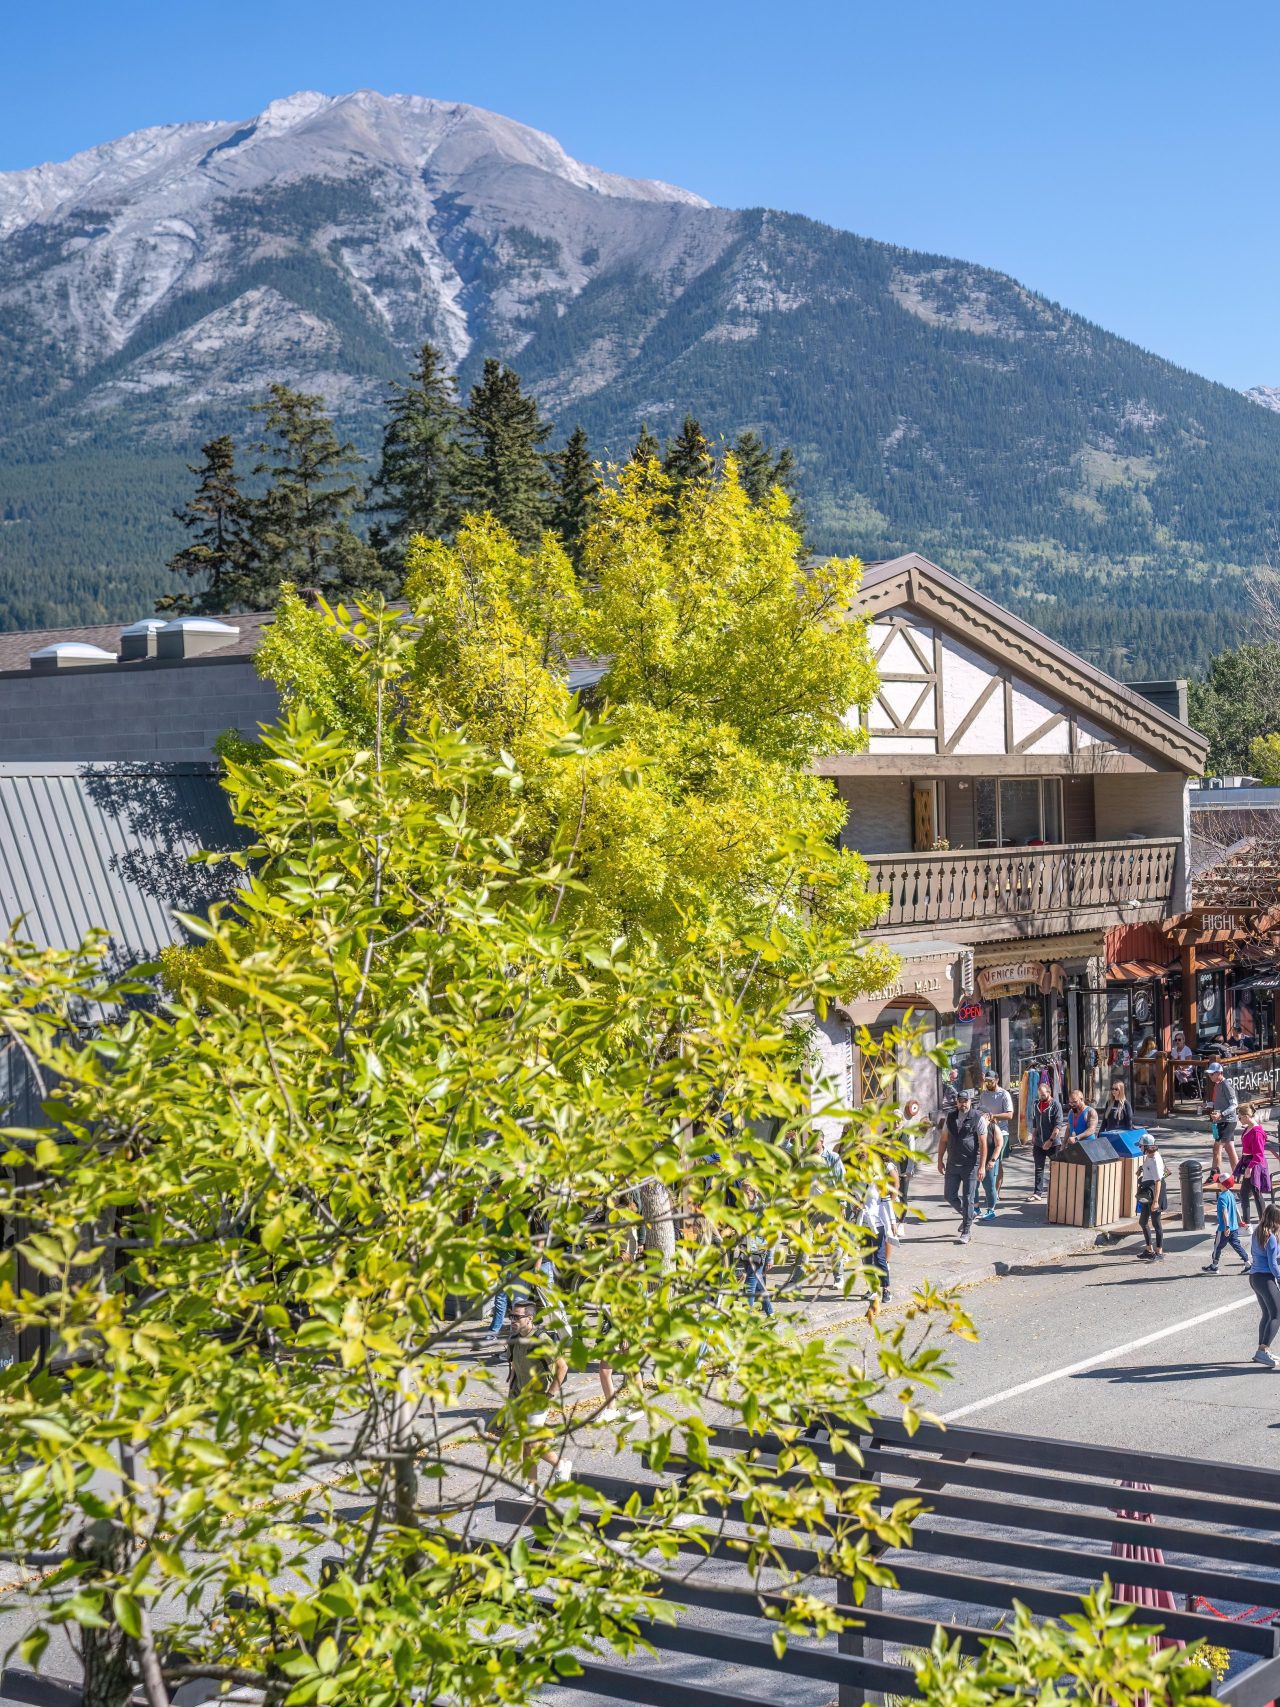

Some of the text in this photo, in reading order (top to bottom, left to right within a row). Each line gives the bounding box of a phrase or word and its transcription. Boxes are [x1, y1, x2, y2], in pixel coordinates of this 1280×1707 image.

[983, 967, 1015, 982] VENICE
[914, 978, 941, 993] MALL
[959, 1006, 982, 1019] OPEN
